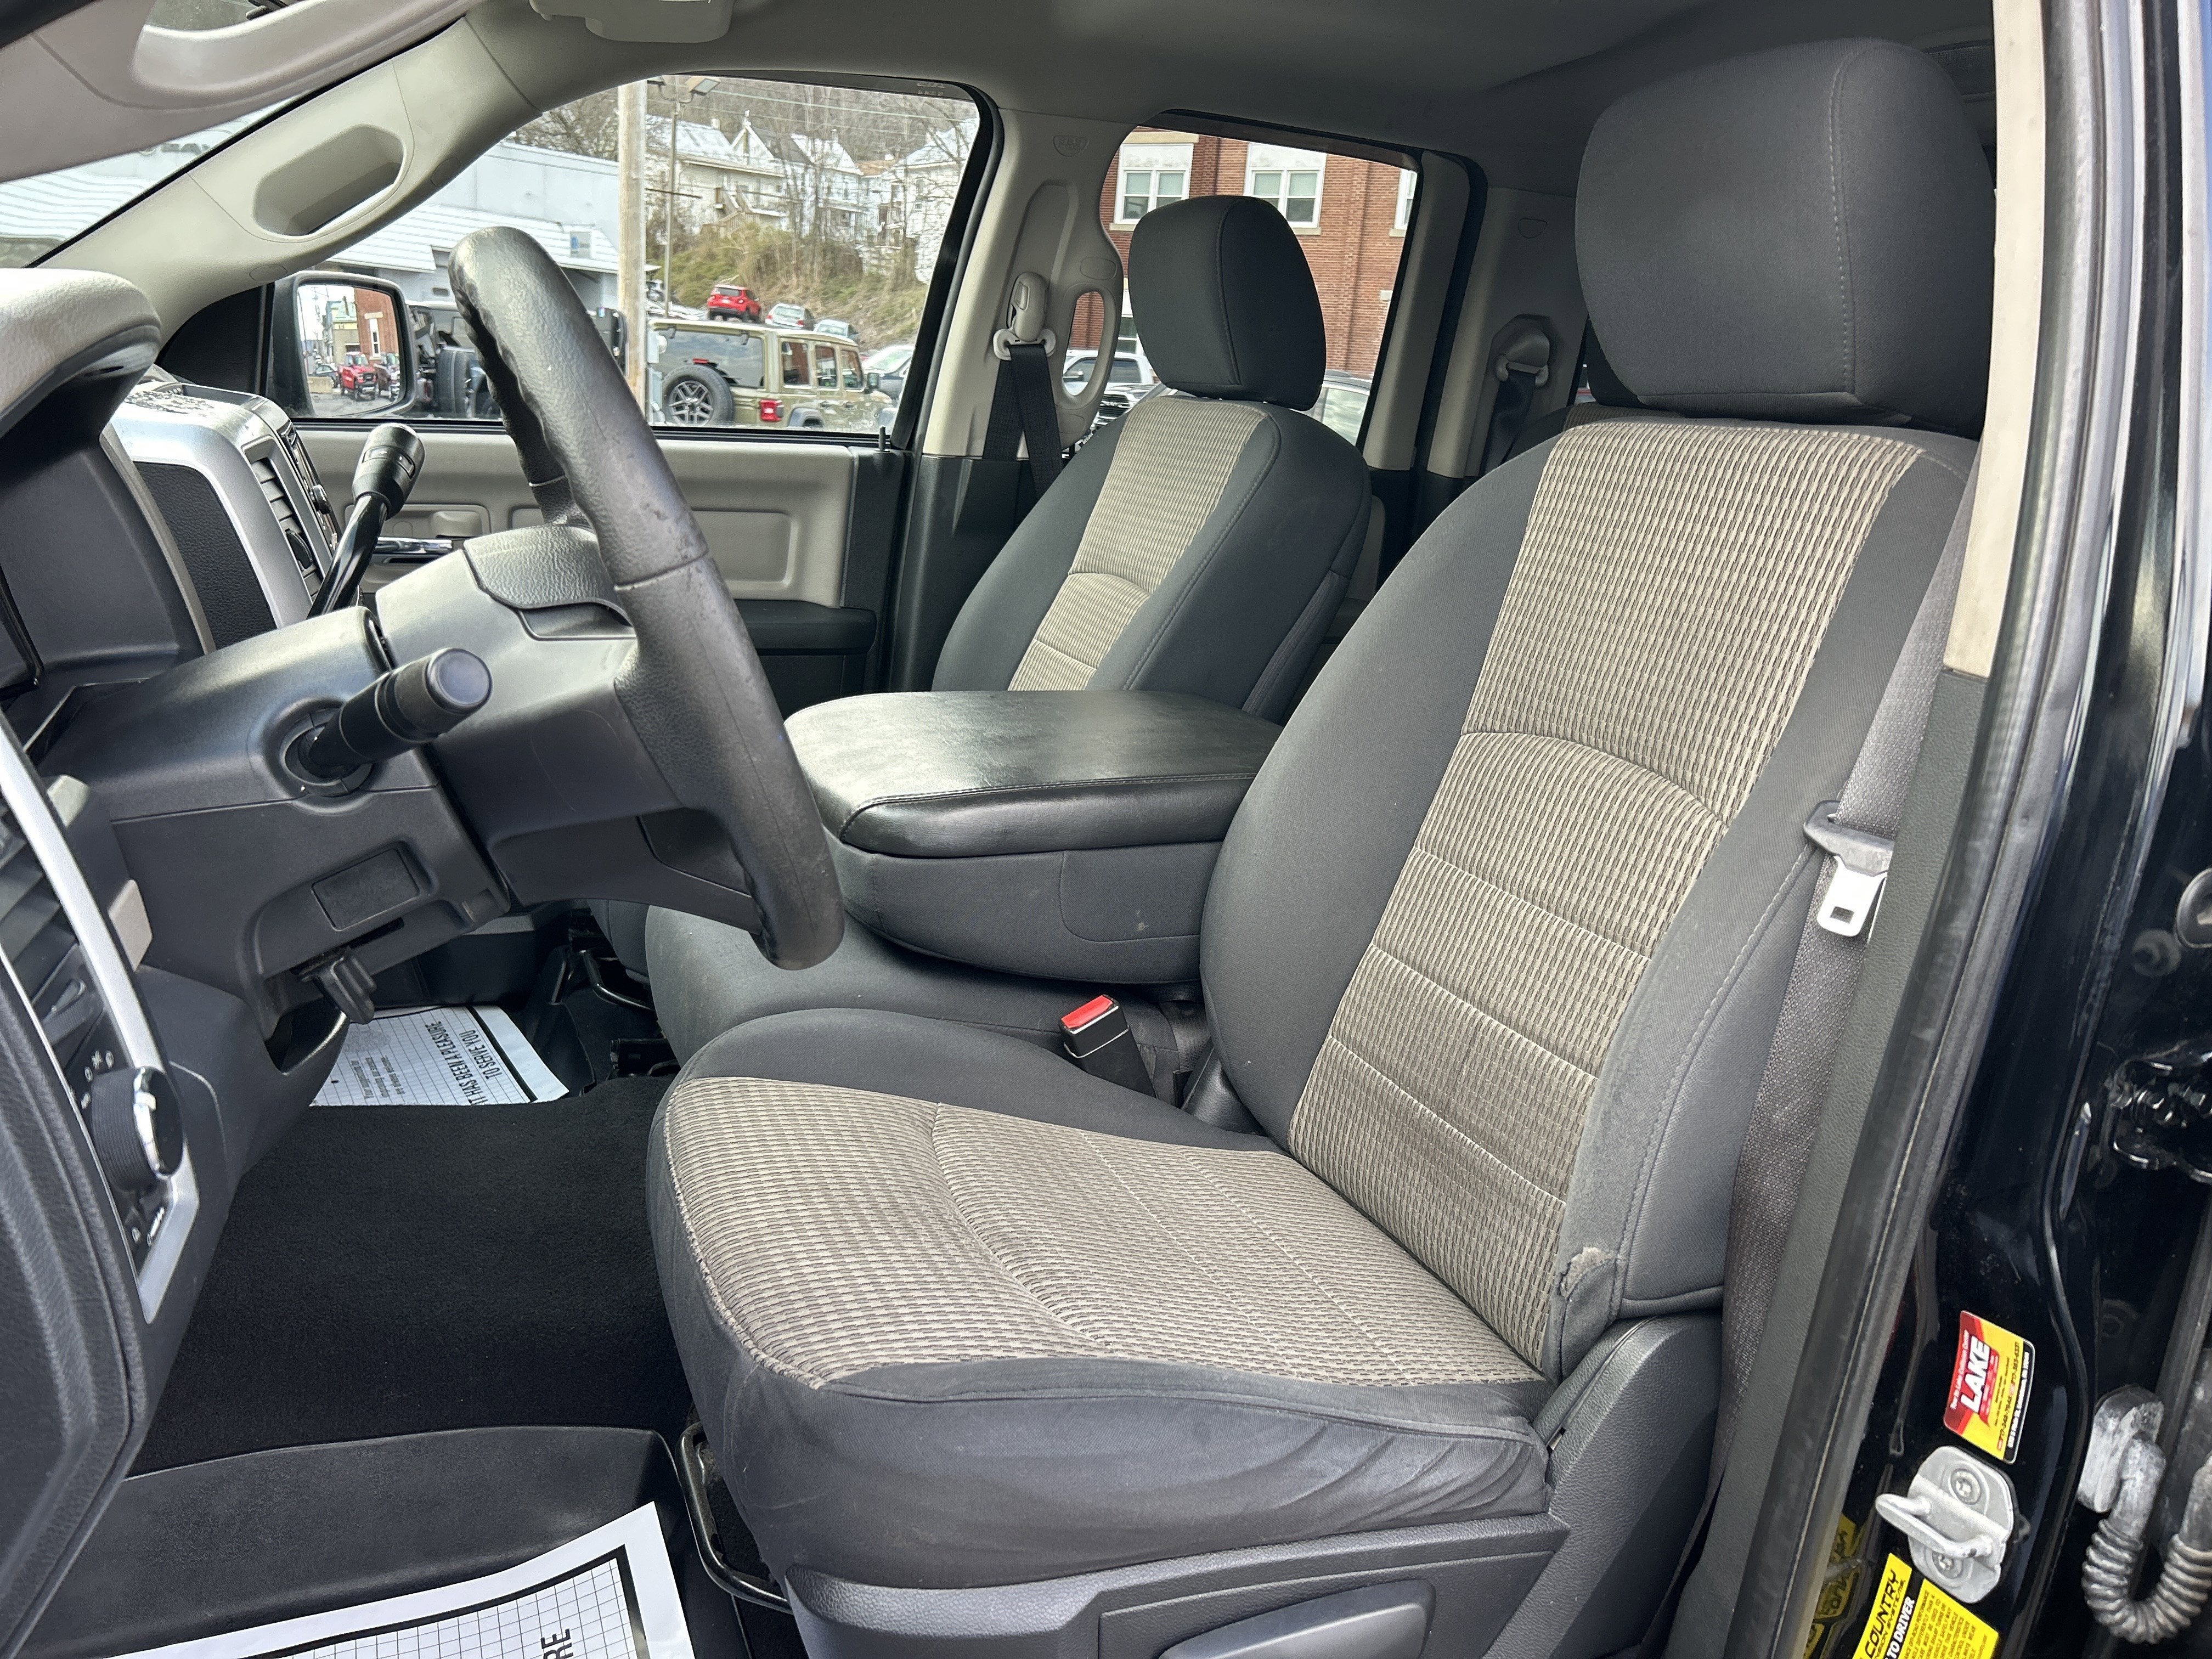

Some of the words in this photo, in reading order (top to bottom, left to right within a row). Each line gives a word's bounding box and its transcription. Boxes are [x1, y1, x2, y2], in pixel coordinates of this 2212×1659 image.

[424, 1021, 458, 1055] PLEASURE
[459, 1030, 481, 1047] YOU
[468, 1045, 495, 1068] SERVE
[448, 1060, 472, 1080] BEEN
[482, 1068, 503, 1080] TO
[459, 1080, 482, 1096] HAS
[1960, 1335, 1990, 1413] LAKE
[1865, 1570, 1899, 1659] COUNTRY
[1894, 1596, 1915, 1643] DRIVER
